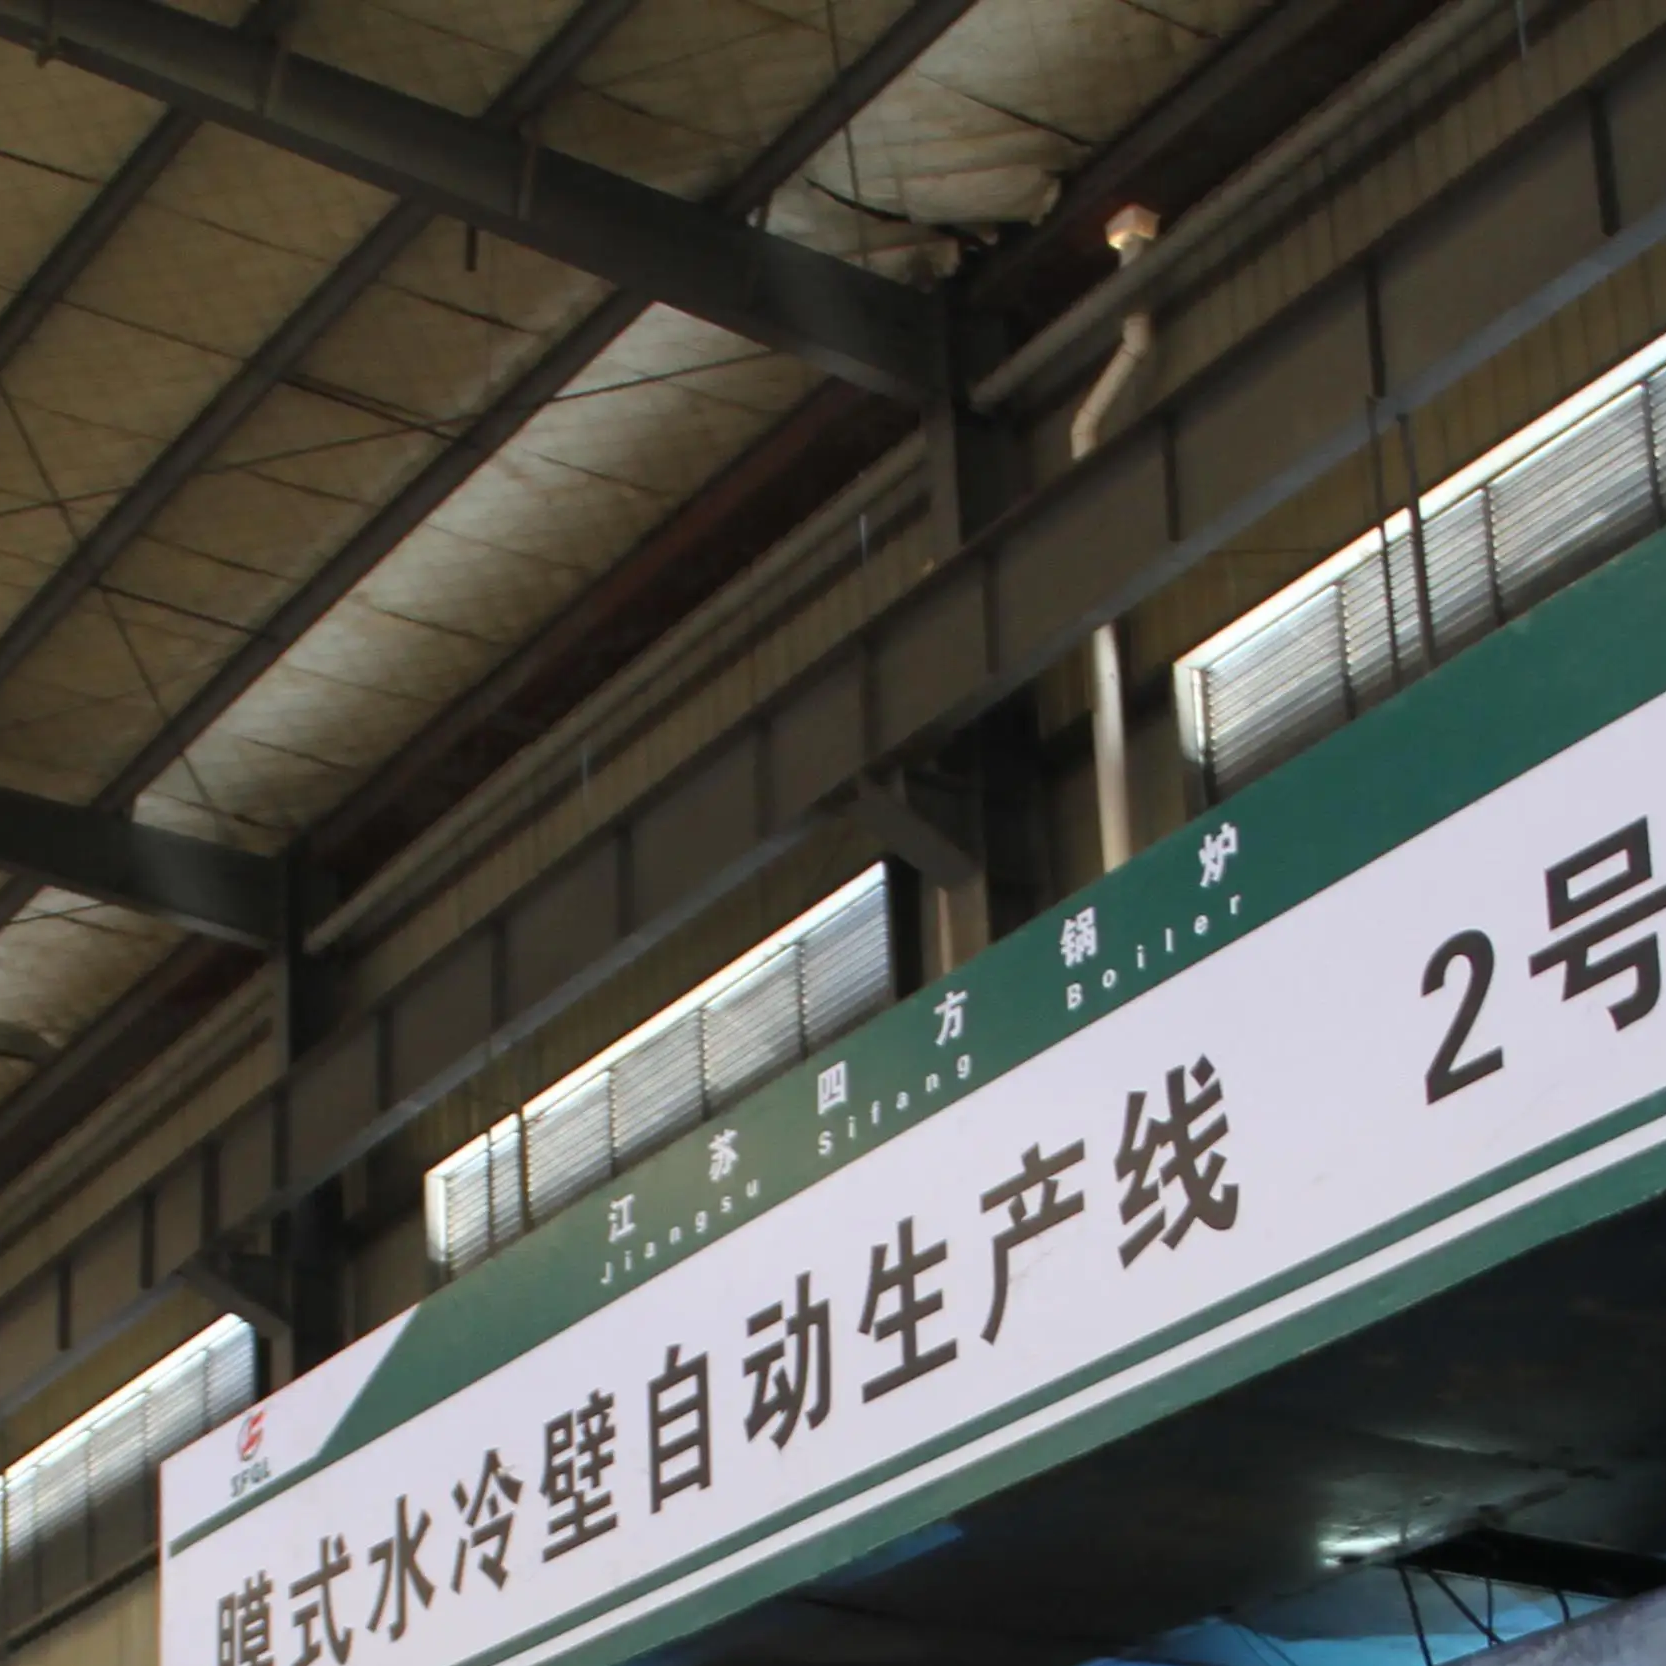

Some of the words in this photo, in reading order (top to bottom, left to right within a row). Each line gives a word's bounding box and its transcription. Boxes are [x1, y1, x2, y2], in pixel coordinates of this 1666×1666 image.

[599, 1178, 759, 1285] Jiangsu
[817, 1054, 972, 1157] Sifang
[1065, 891, 1240, 1010] Boiler
[608, 822, 1239, 1244] 江苏四方锅炉
